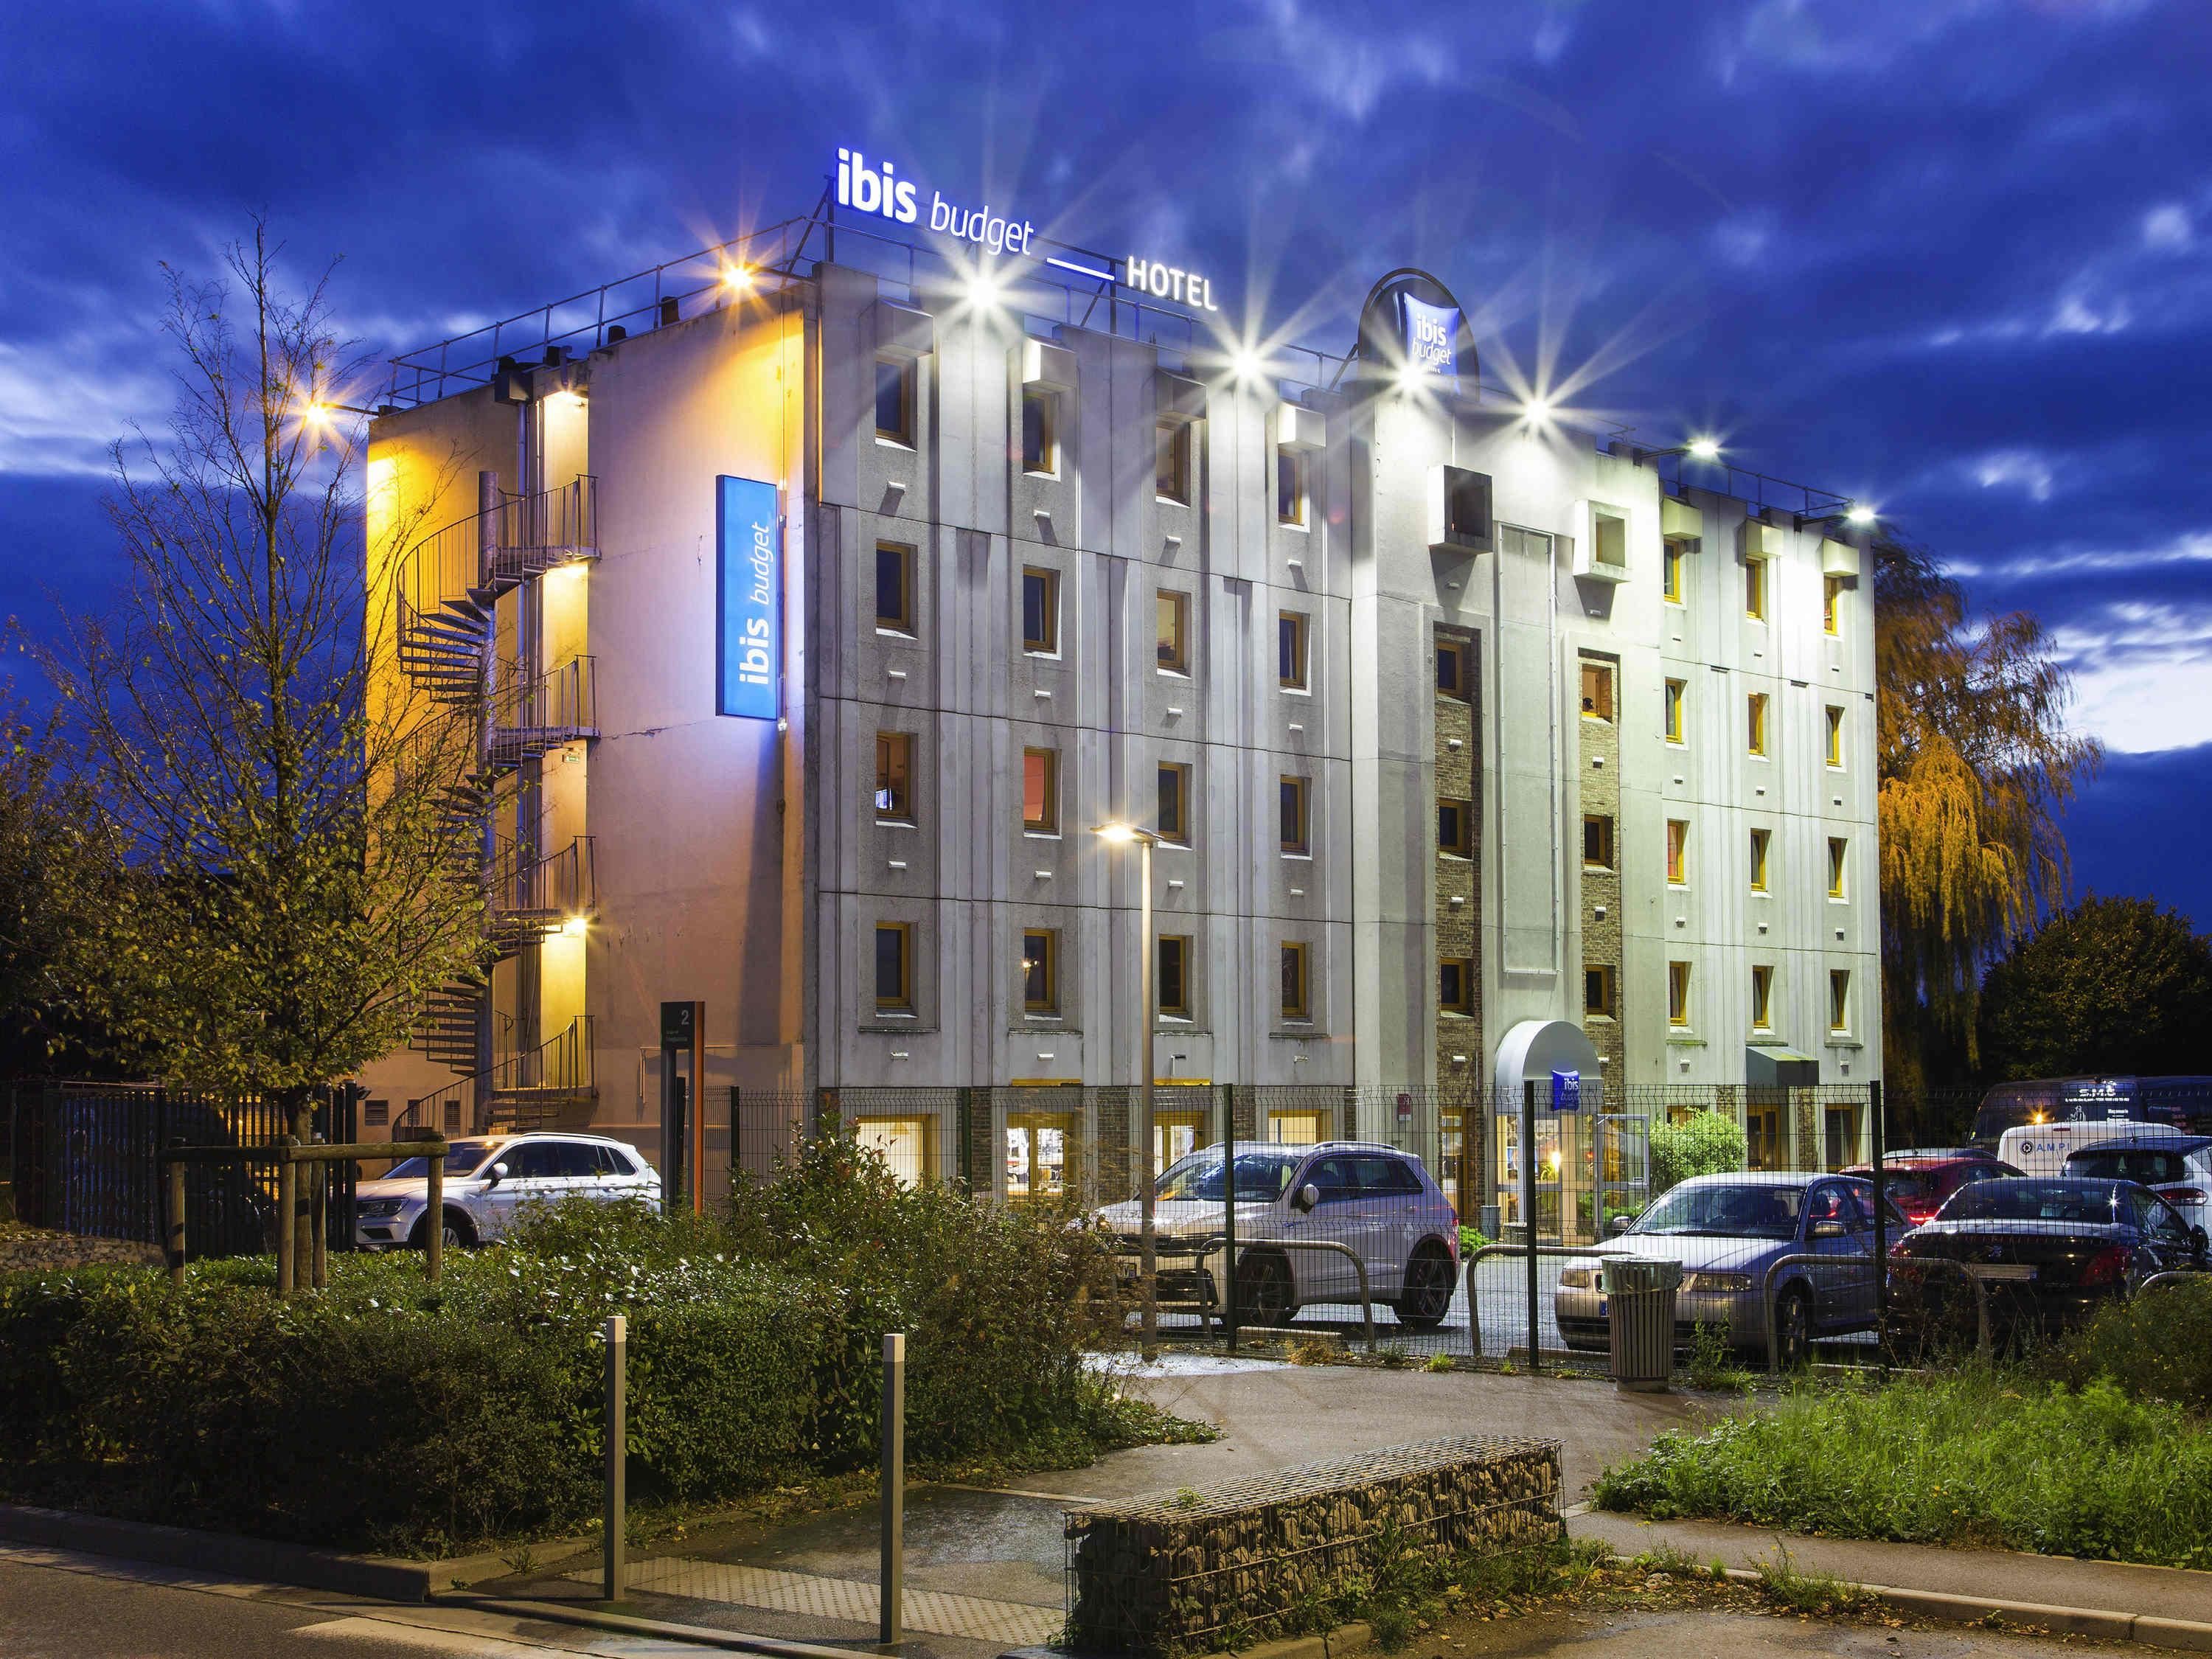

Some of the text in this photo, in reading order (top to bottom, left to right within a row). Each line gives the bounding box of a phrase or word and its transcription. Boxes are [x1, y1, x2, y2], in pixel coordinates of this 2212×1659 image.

[837, 147, 1217, 311] ibis budget HOTEL
[1416, 313, 1447, 347] ibis
[1412, 337, 1452, 366] budget
[740, 521, 773, 685] ibis budget
[681, 1009, 690, 1026] 2
[1564, 1077, 1579, 1091] ibis
